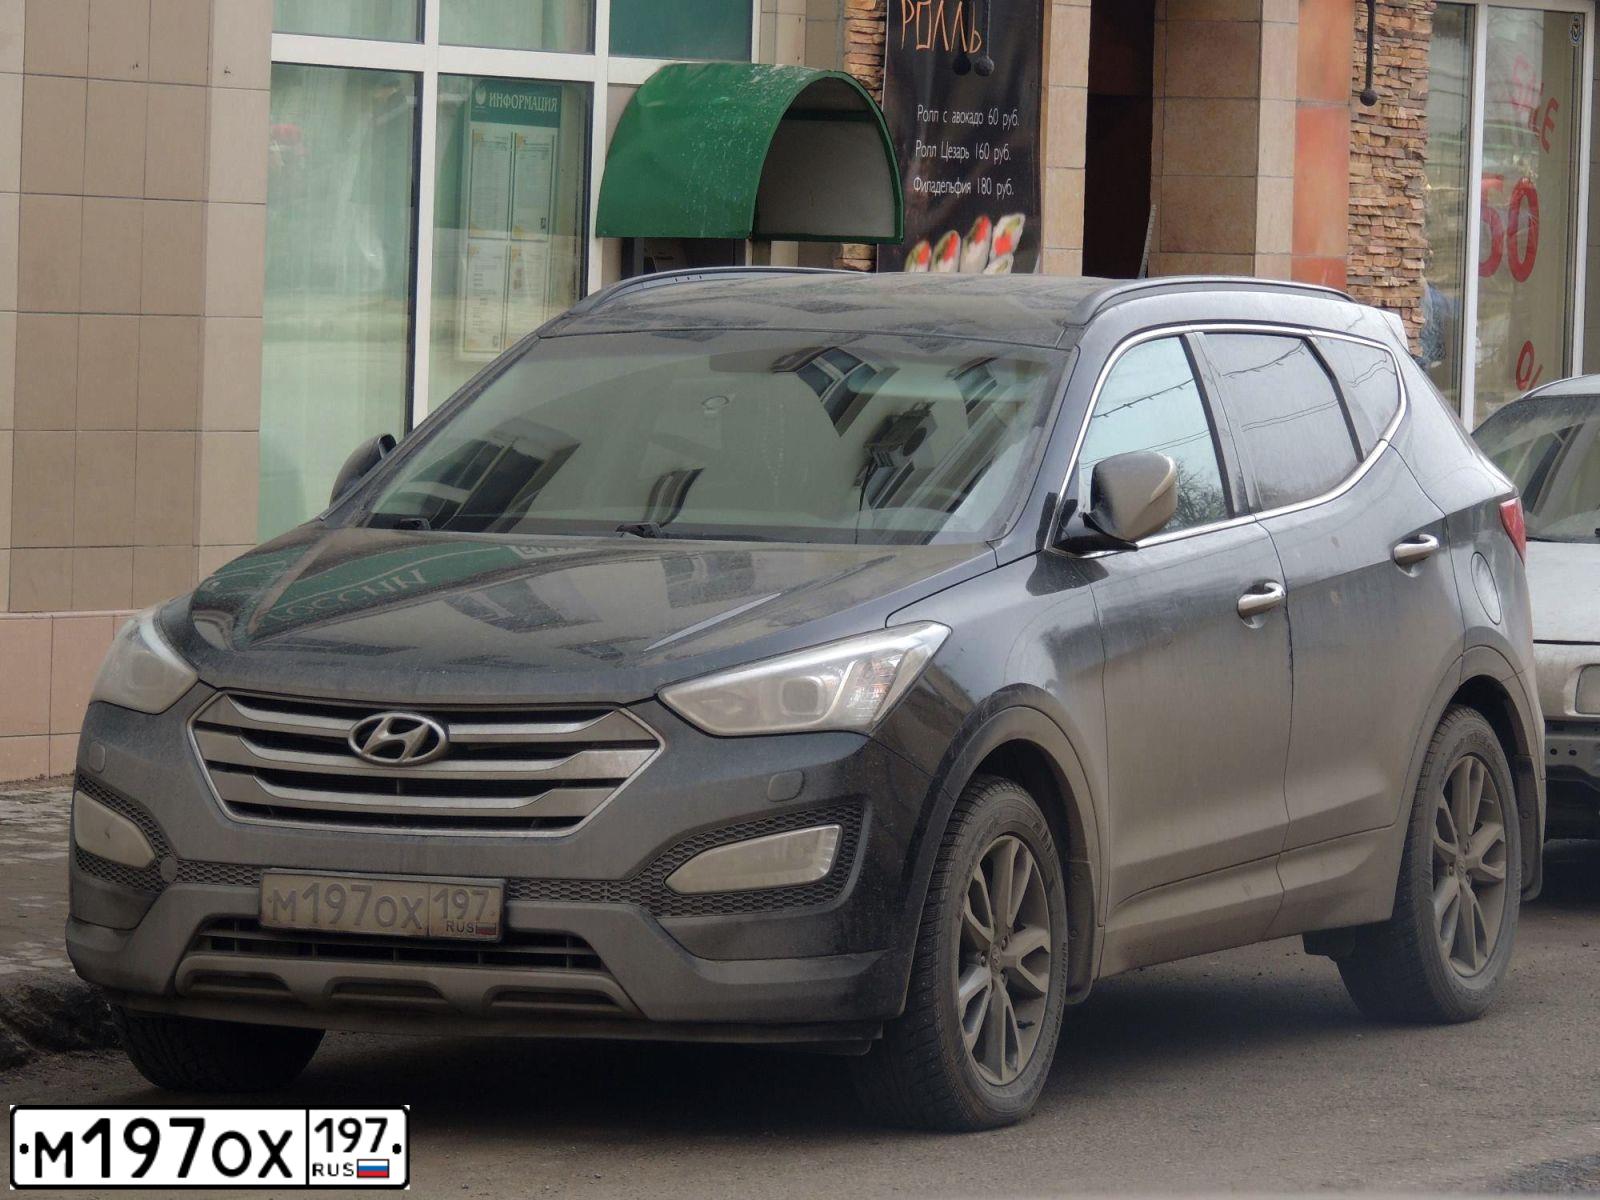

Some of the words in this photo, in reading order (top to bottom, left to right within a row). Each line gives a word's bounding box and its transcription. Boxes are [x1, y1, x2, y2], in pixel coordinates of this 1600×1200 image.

[489, 92, 558, 113] ИНФОРМАЦИЯ
[917, 104, 939, 123] Ролл
[951, 110, 984, 127] авокадо
[988, 107, 999, 126] 60
[1002, 109, 1020, 131] руб.
[915, 139, 937, 158] Ролл
[940, 141, 970, 163] Цезарь
[975, 142, 990, 160] 160
[993, 143, 1012, 165] руб.
[913, 176, 972, 198] Филадельфия
[977, 177, 992, 195] 180
[996, 178, 1015, 200] руб.
[1478, 172, 1539, 283] 50
[430, 888, 490, 921] 197
[446, 920, 475, 933] RUS
